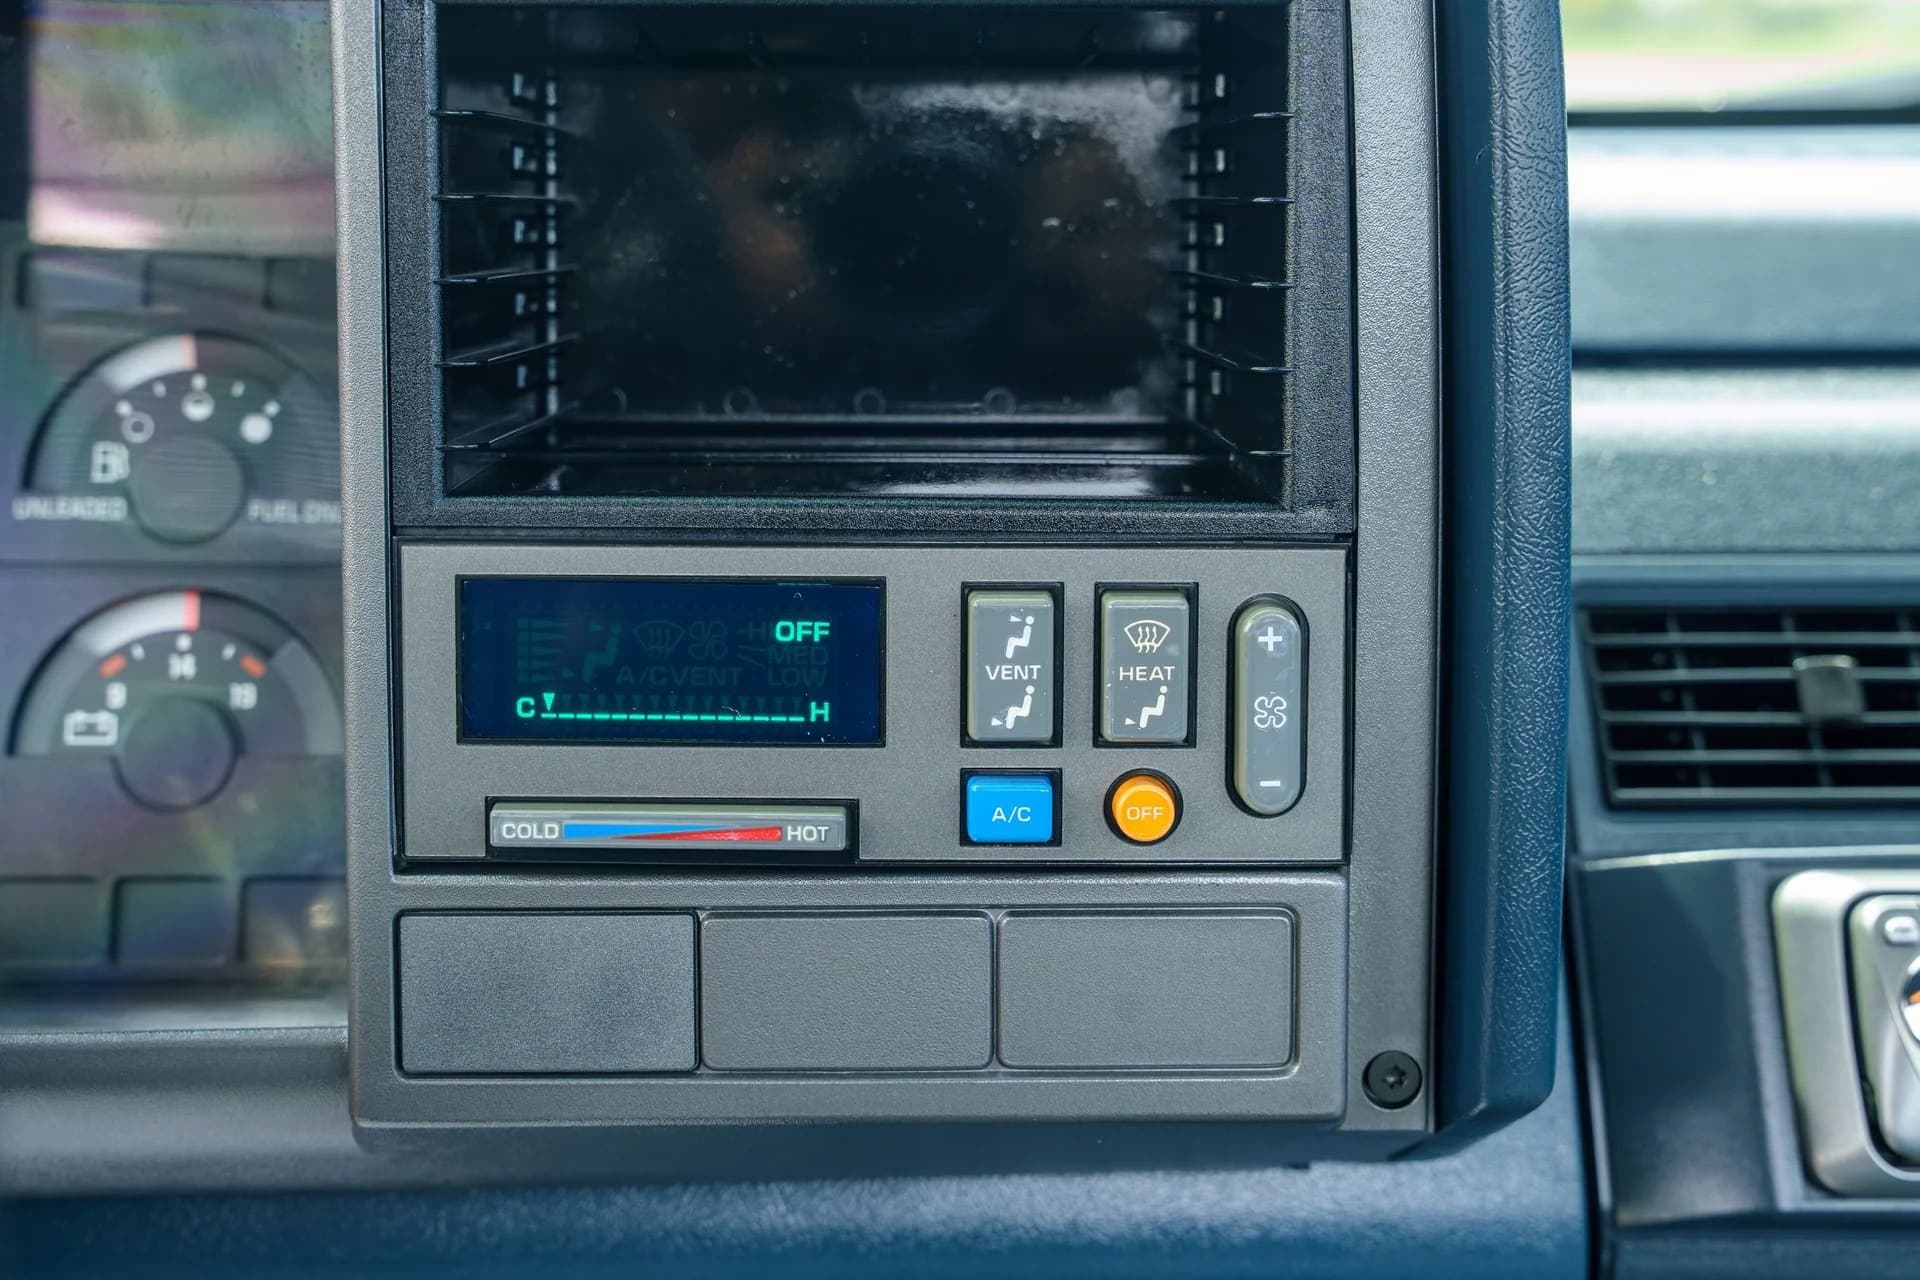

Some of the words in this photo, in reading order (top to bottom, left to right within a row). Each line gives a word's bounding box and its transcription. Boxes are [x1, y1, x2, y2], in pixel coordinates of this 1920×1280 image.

[248, 499, 298, 523] FUEL
[775, 620, 831, 643] OFF
[767, 667, 827, 688] LOW
[985, 665, 1041, 681] VENT
[1119, 666, 1175, 681] HEAT
[516, 697, 536, 720] C
[810, 701, 830, 723] H
[991, 806, 1032, 823] A/C
[1126, 806, 1164, 821] OFF
[502, 823, 560, 840] COLD
[787, 825, 830, 842] HOT
